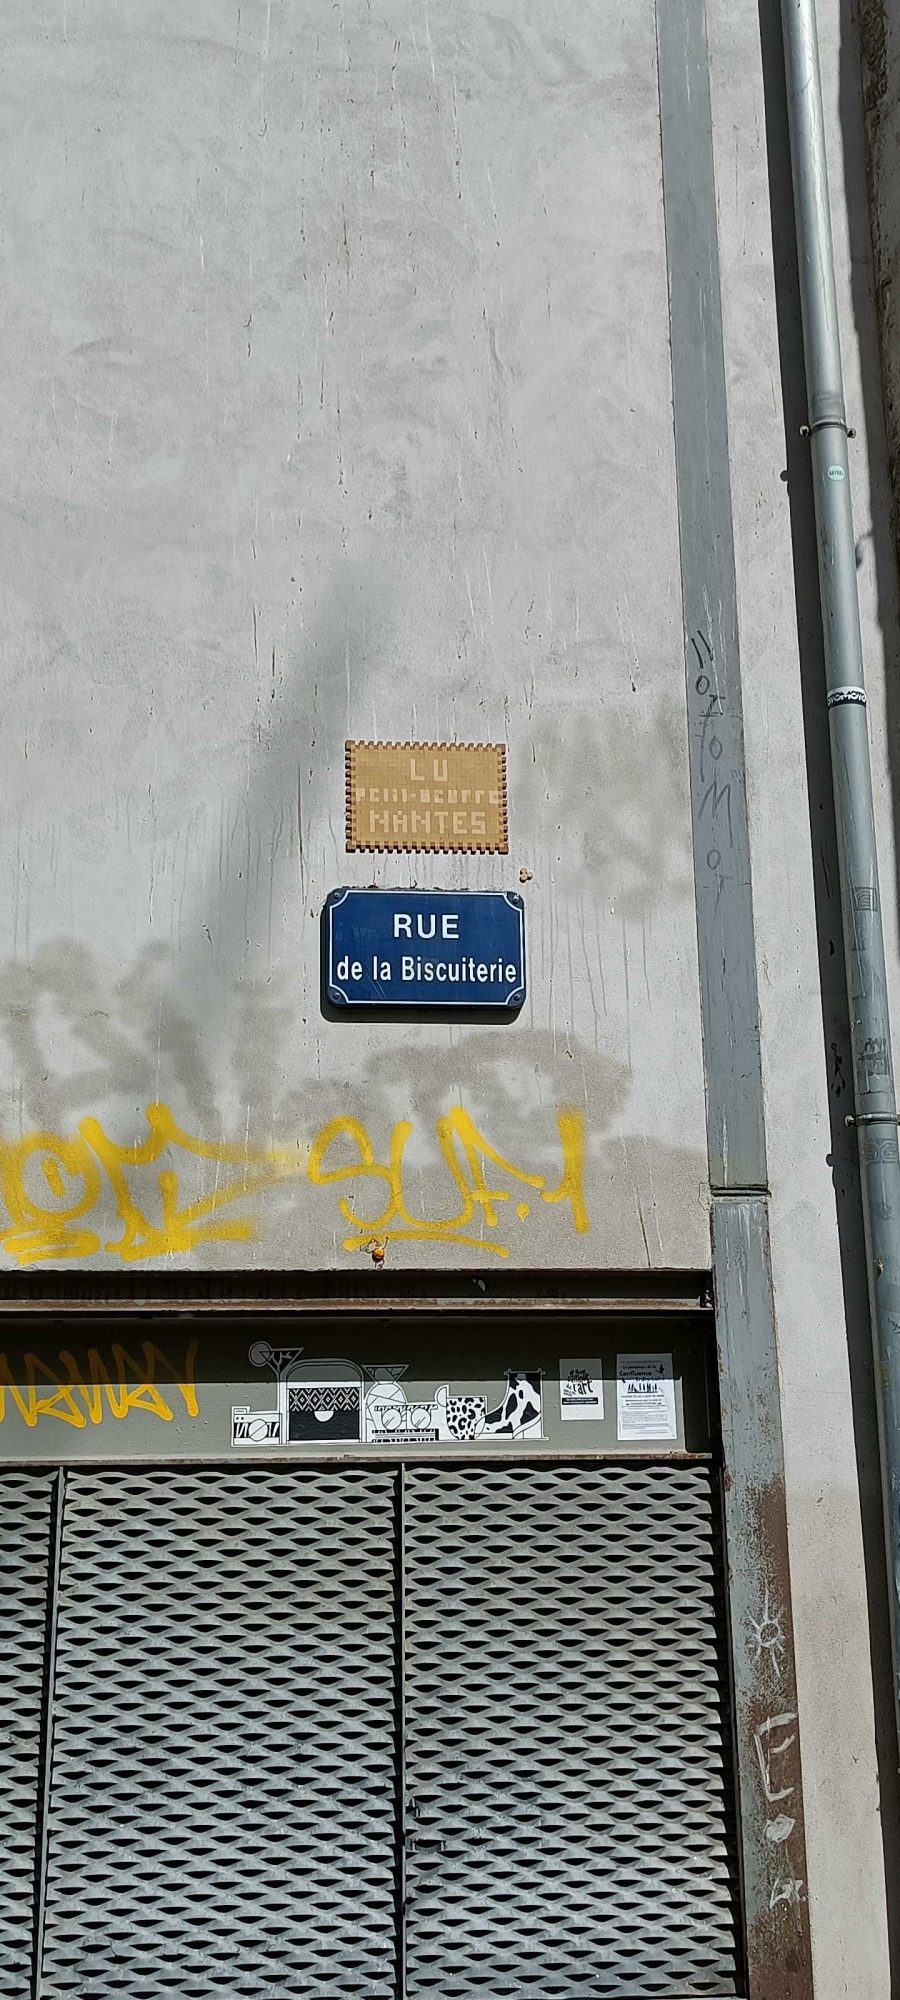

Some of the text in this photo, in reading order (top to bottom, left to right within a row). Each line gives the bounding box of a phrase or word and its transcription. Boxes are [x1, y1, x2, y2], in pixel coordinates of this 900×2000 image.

[369, 809, 487, 835] NANTES
[393, 913, 460, 939] RUE
[336, 955, 518, 982] de la Biscuiterie
